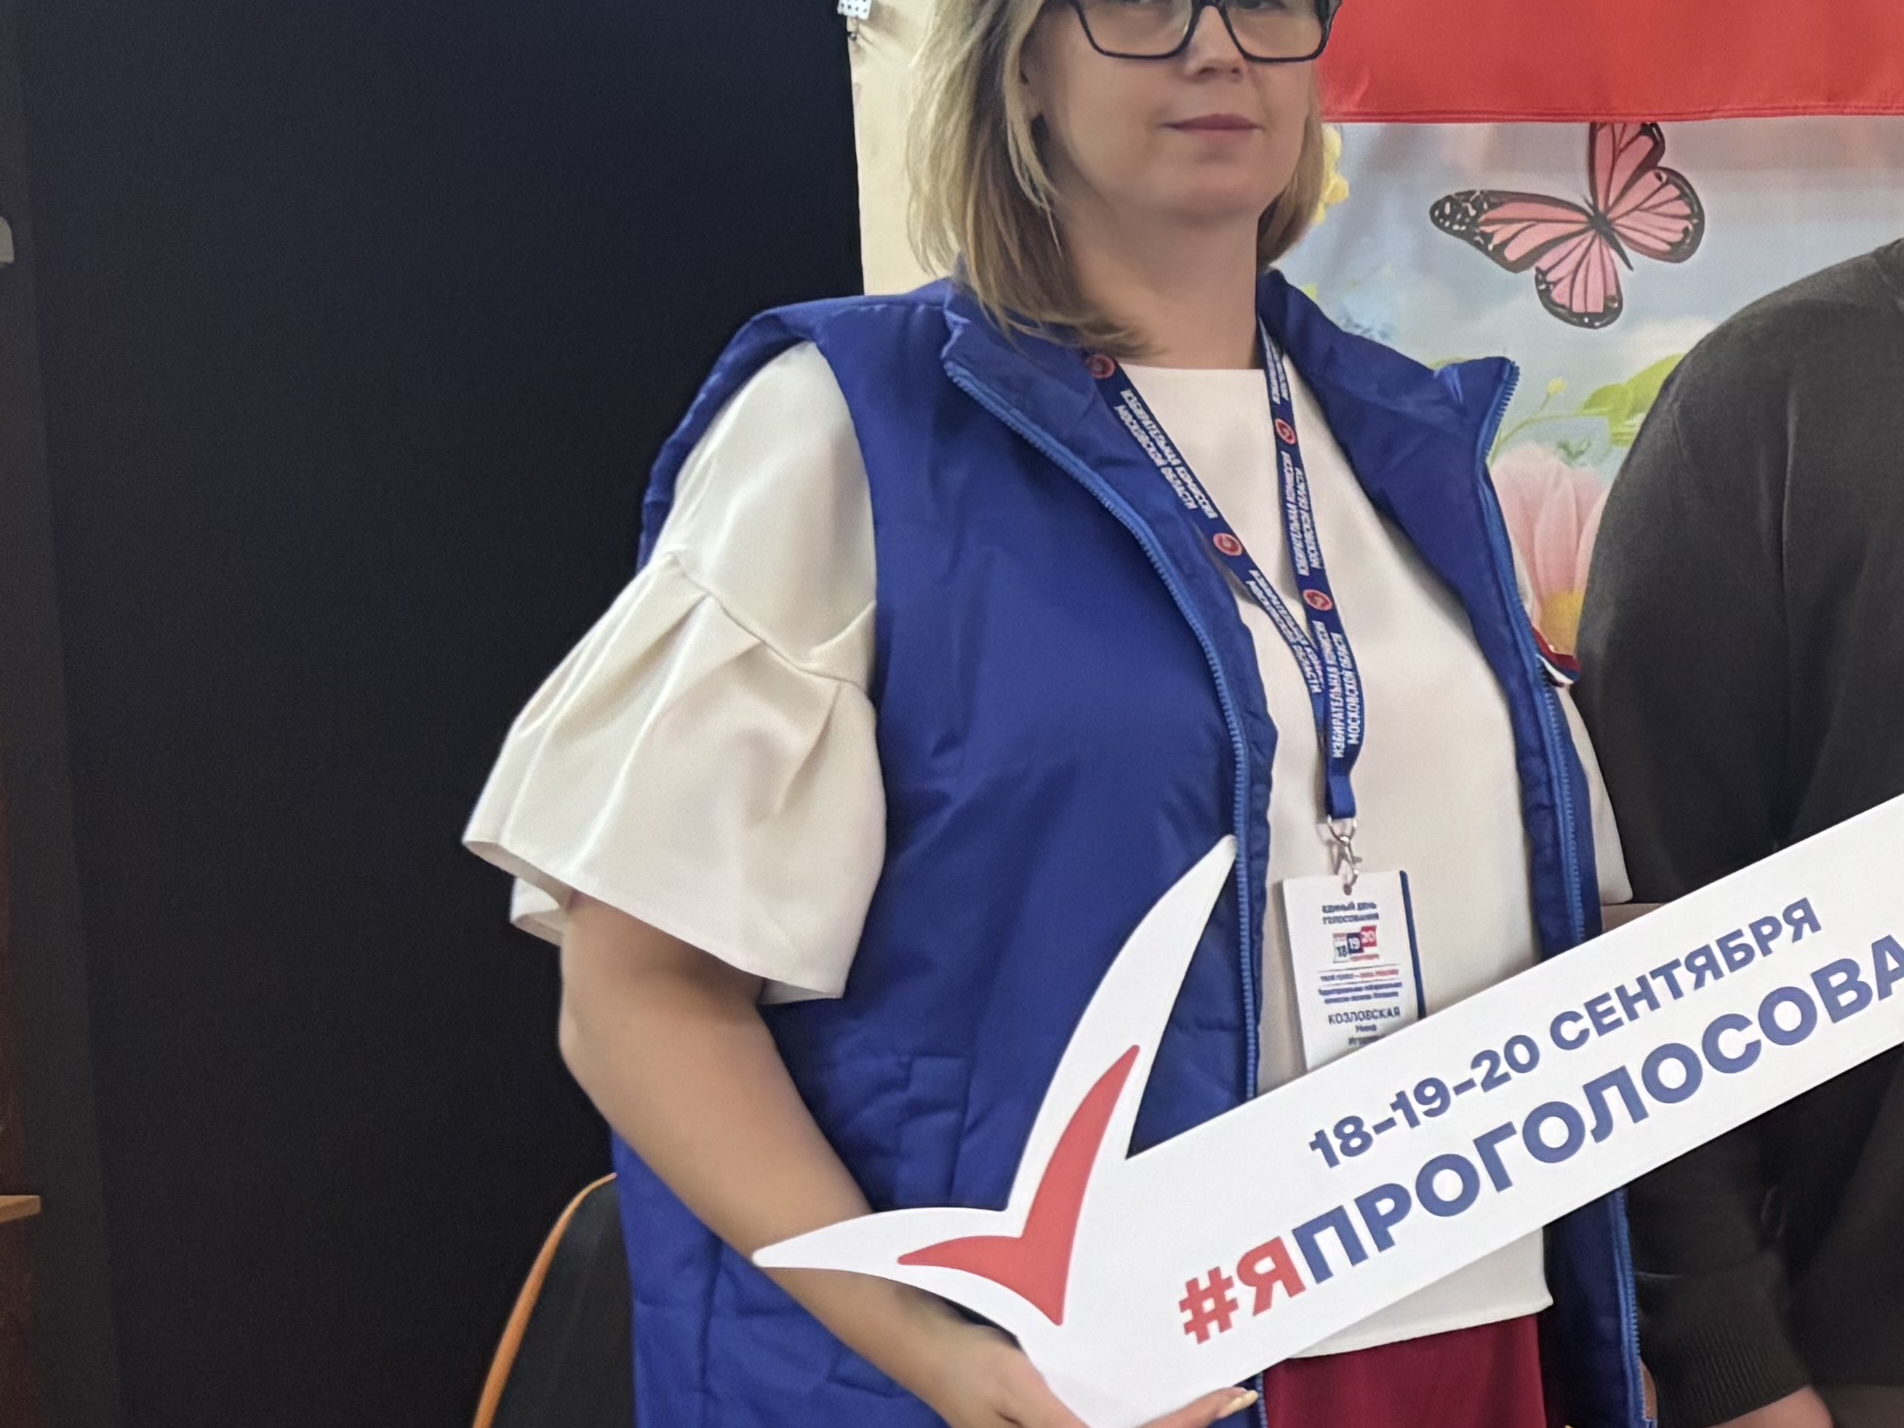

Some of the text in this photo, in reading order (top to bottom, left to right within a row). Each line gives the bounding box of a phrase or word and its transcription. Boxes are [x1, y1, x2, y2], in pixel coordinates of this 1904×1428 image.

[1308, 898, 1824, 1169] 18-19-20 СЕНТЯБРЯ
[1328, 1006, 1400, 1024] КОЗЛОВСКАЯ
